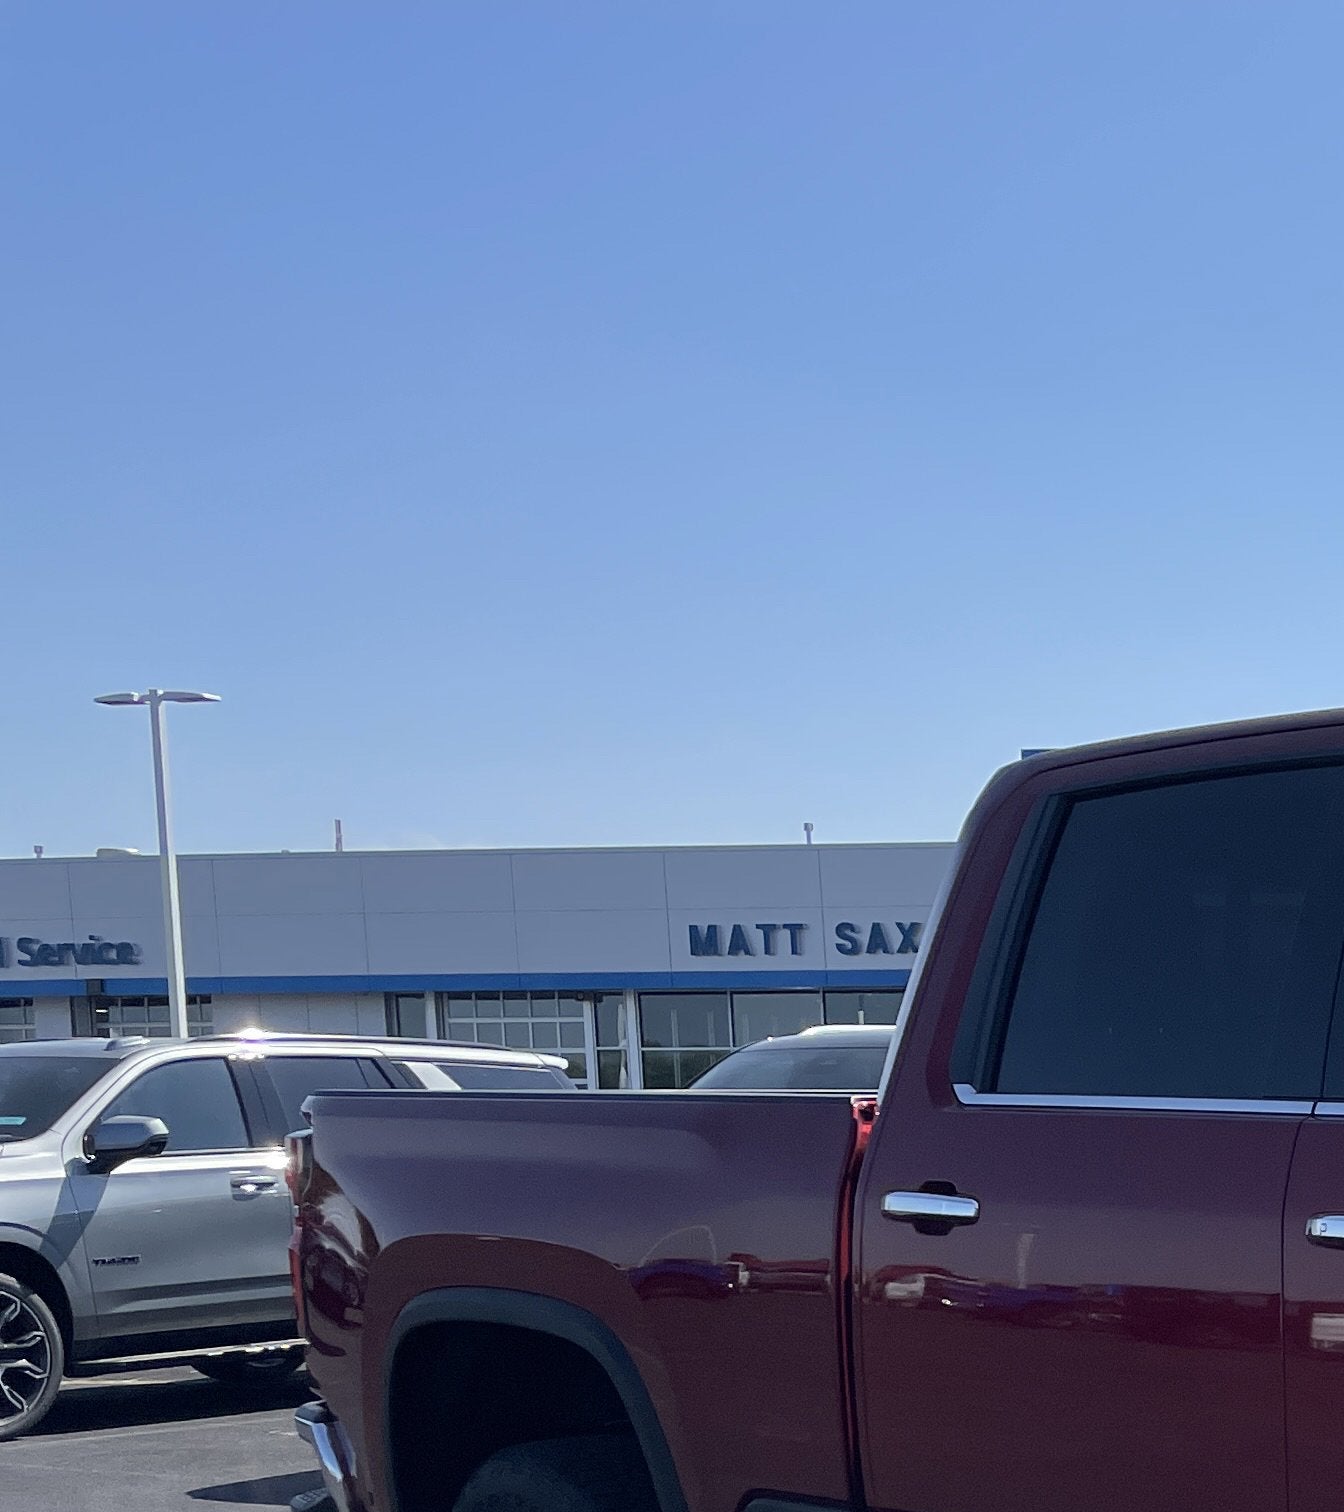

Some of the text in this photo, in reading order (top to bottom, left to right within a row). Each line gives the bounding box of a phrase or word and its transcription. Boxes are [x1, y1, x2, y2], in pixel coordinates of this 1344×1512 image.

[17, 934, 141, 967] Service
[688, 921, 924, 956] MATT SAX
